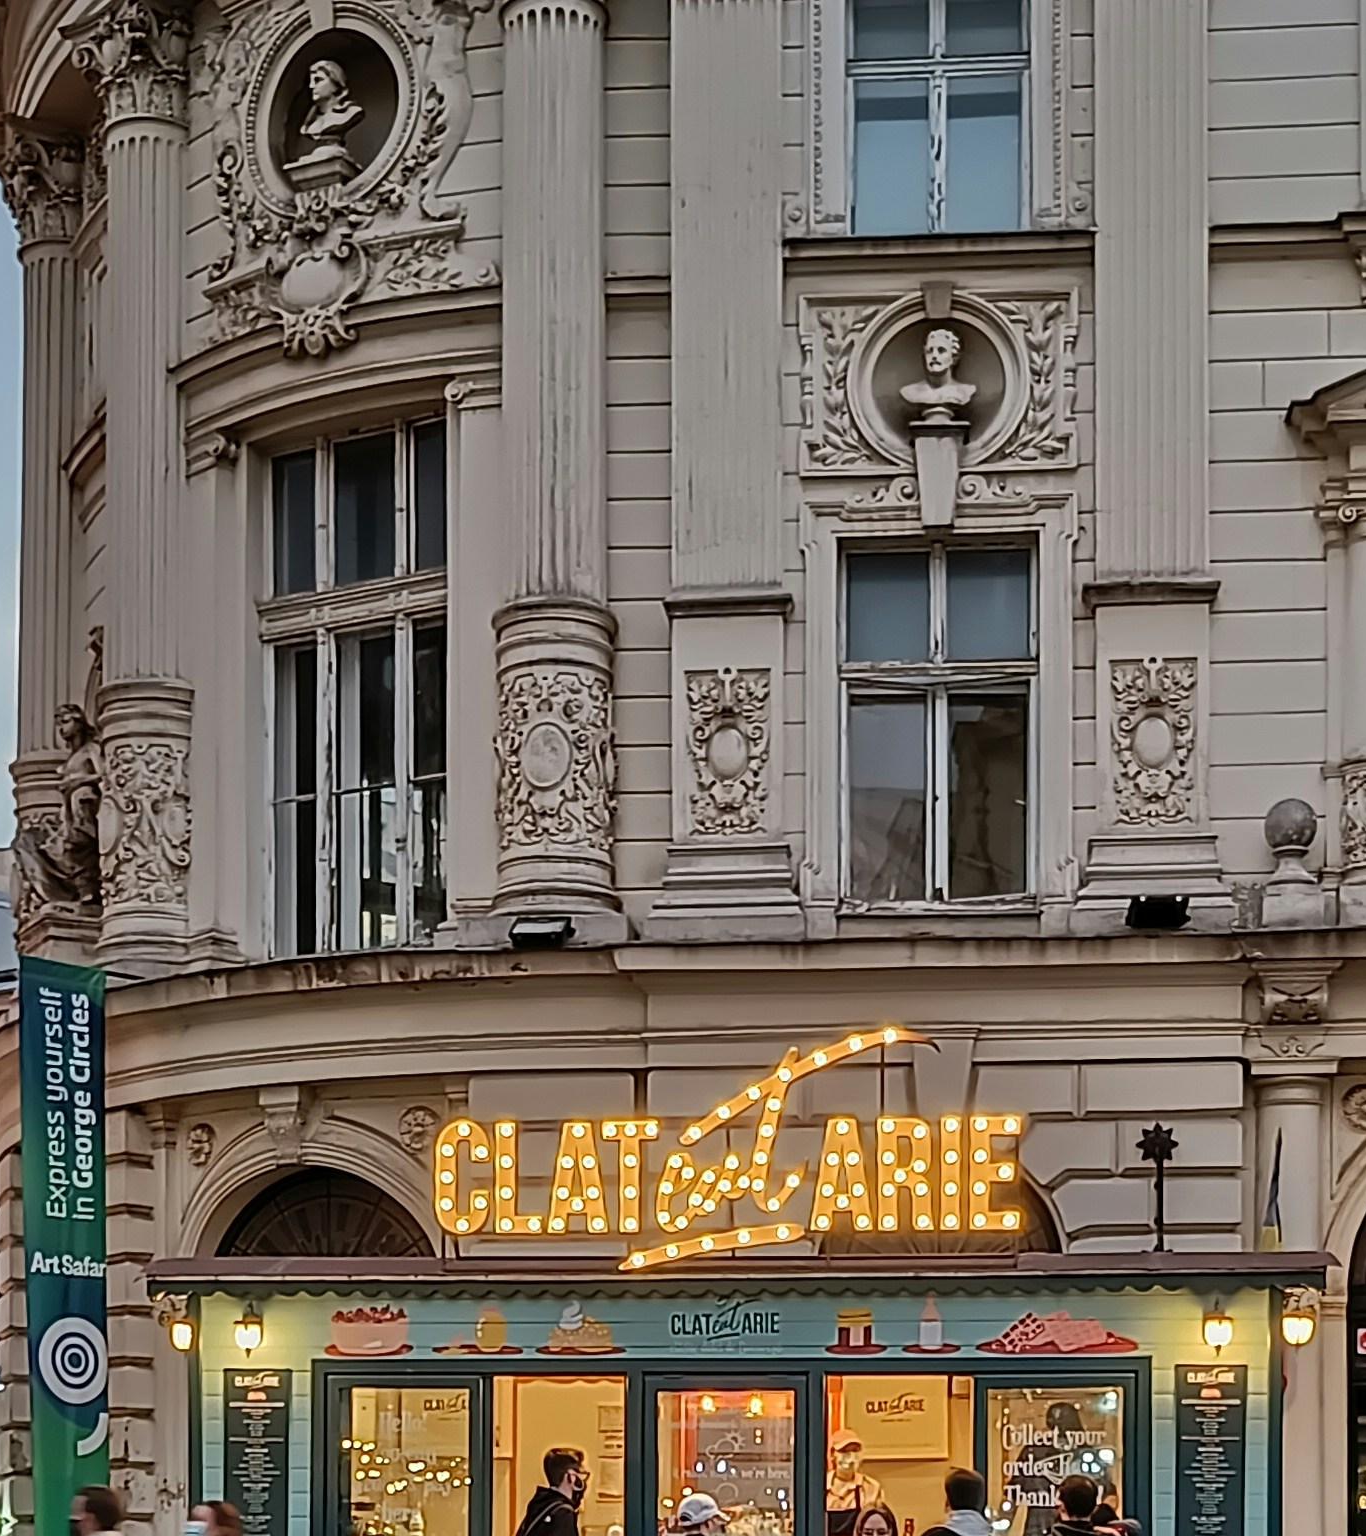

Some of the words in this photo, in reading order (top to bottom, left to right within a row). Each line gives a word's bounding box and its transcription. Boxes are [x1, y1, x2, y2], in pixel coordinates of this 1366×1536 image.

[39, 986, 69, 1102] yourself
[68, 993, 91, 1083] Circles
[46, 1110, 70, 1218] Express
[72, 1089, 96, 1188] George
[435, 1118, 659, 1235] CLAT
[809, 1115, 1022, 1232] ARIE
[71, 1197, 95, 1220] in
[30, 1251, 61, 1274] Art
[671, 1313, 713, 1335] CLAT
[742, 1312, 780, 1334] ARIE
[1003, 1424, 1063, 1450] Collect
[1065, 1430, 1107, 1450] your
